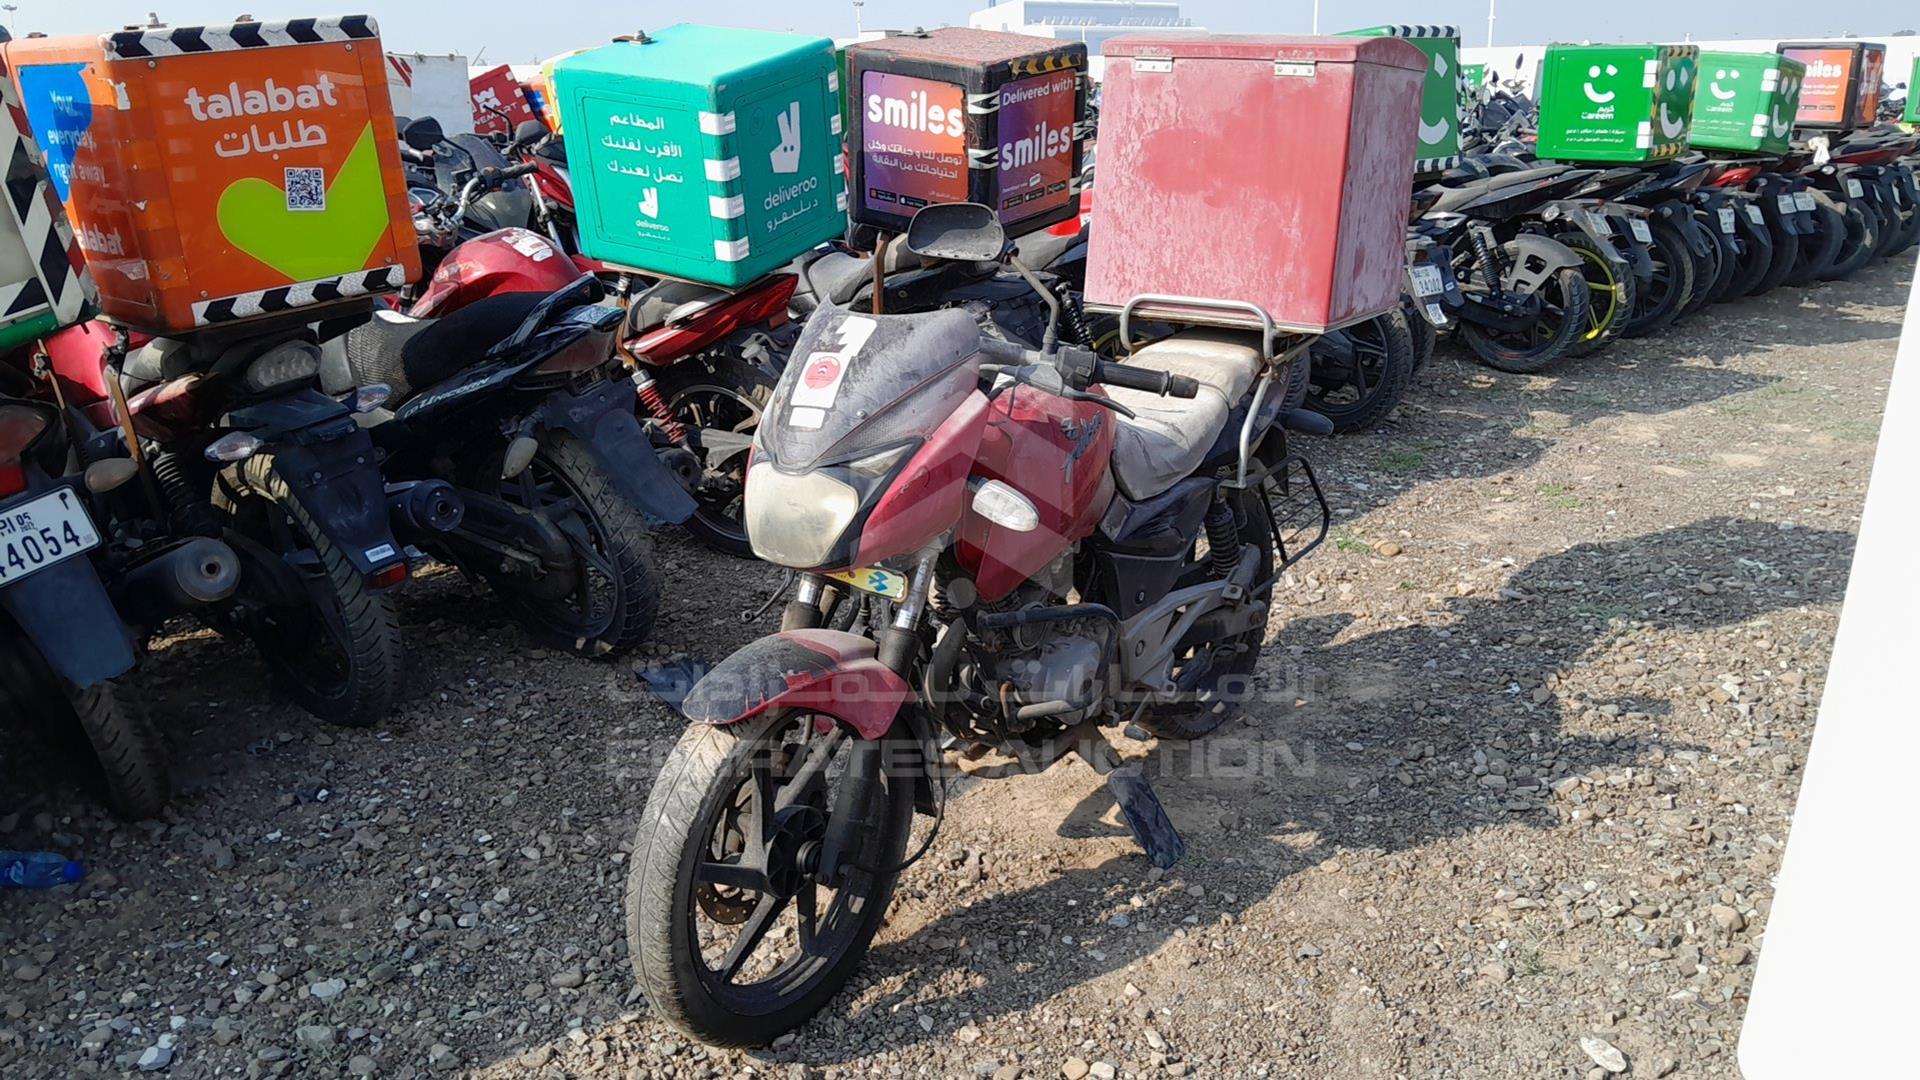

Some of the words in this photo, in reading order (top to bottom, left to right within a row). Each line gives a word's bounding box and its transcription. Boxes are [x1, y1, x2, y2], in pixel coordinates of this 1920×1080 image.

[49, 89, 74, 114] Your
[184, 74, 337, 121] talabat
[1002, 82, 1051, 106] Delivered
[1052, 76, 1074, 93] with
[609, 112, 665, 130] المطاعم
[867, 90, 965, 138] smiles
[215, 119, 328, 160] طلبات
[644, 140, 683, 158] الأقرب
[1001, 121, 1071, 171] smiles
[607, 159, 650, 178] لعندك
[653, 170, 684, 184] تصل
[763, 176, 818, 211] deliveroo
[766, 199, 819, 233] ديليفرو
[0, 520, 80, 578] 4054
